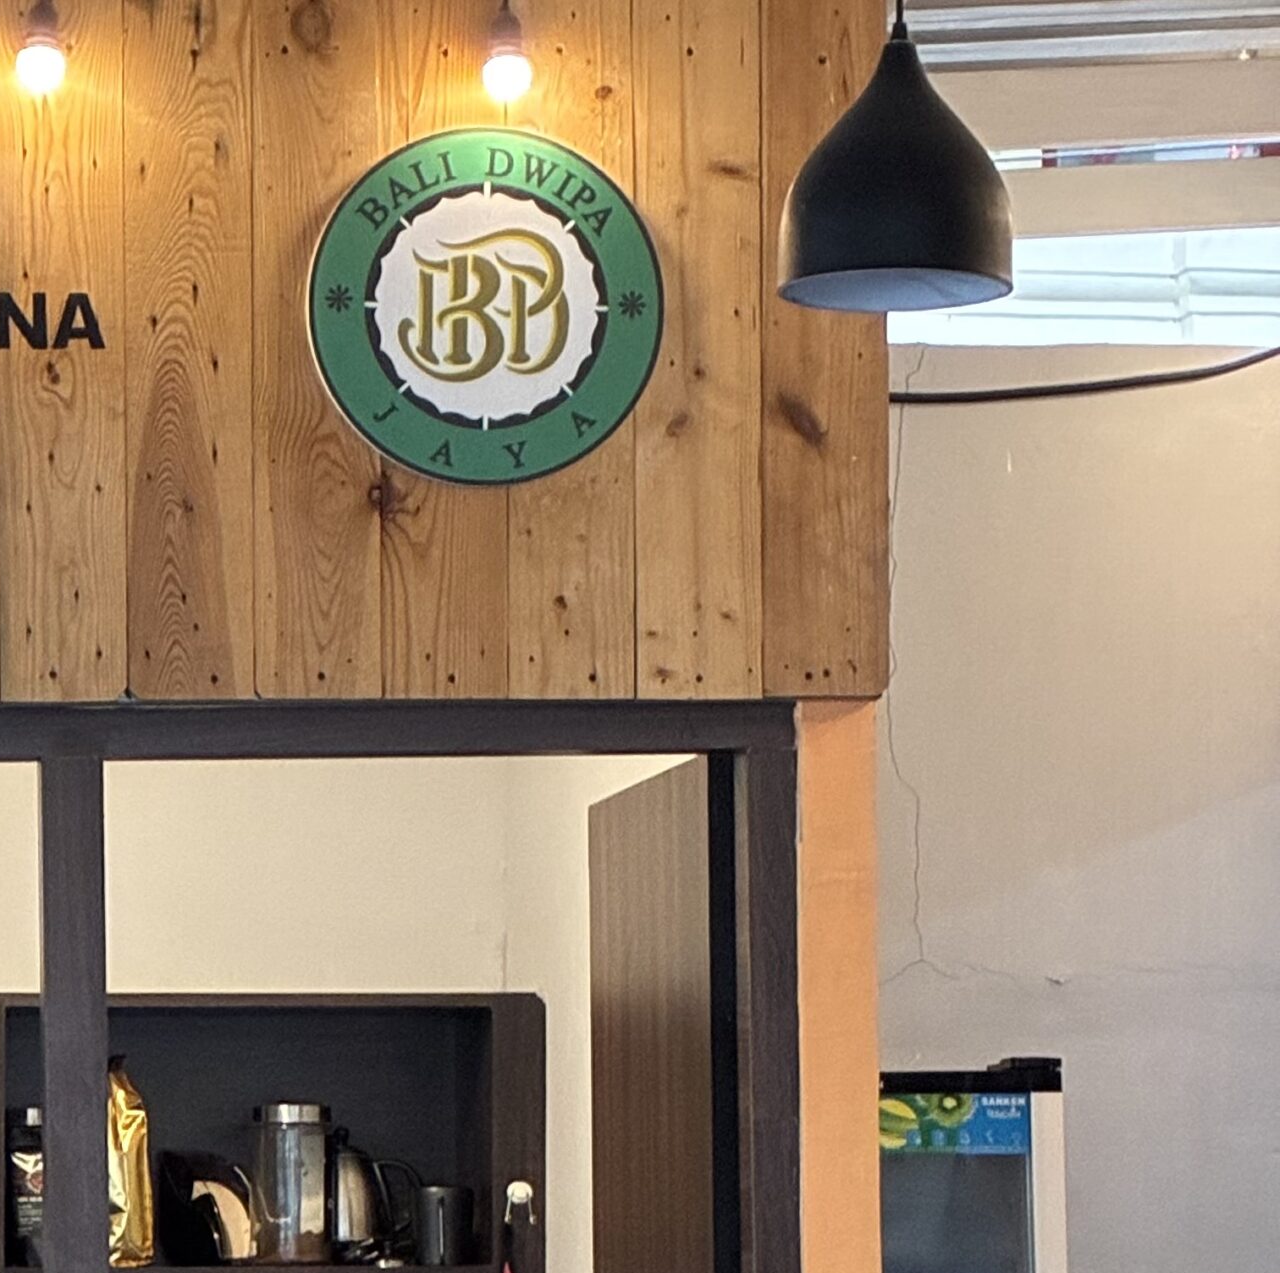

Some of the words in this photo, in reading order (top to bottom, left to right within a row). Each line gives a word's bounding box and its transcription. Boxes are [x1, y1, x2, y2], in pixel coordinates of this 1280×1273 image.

[356, 151, 457, 231] BALI
[486, 147, 614, 237] DWIPA
[373, 403, 596, 468] JAYA
